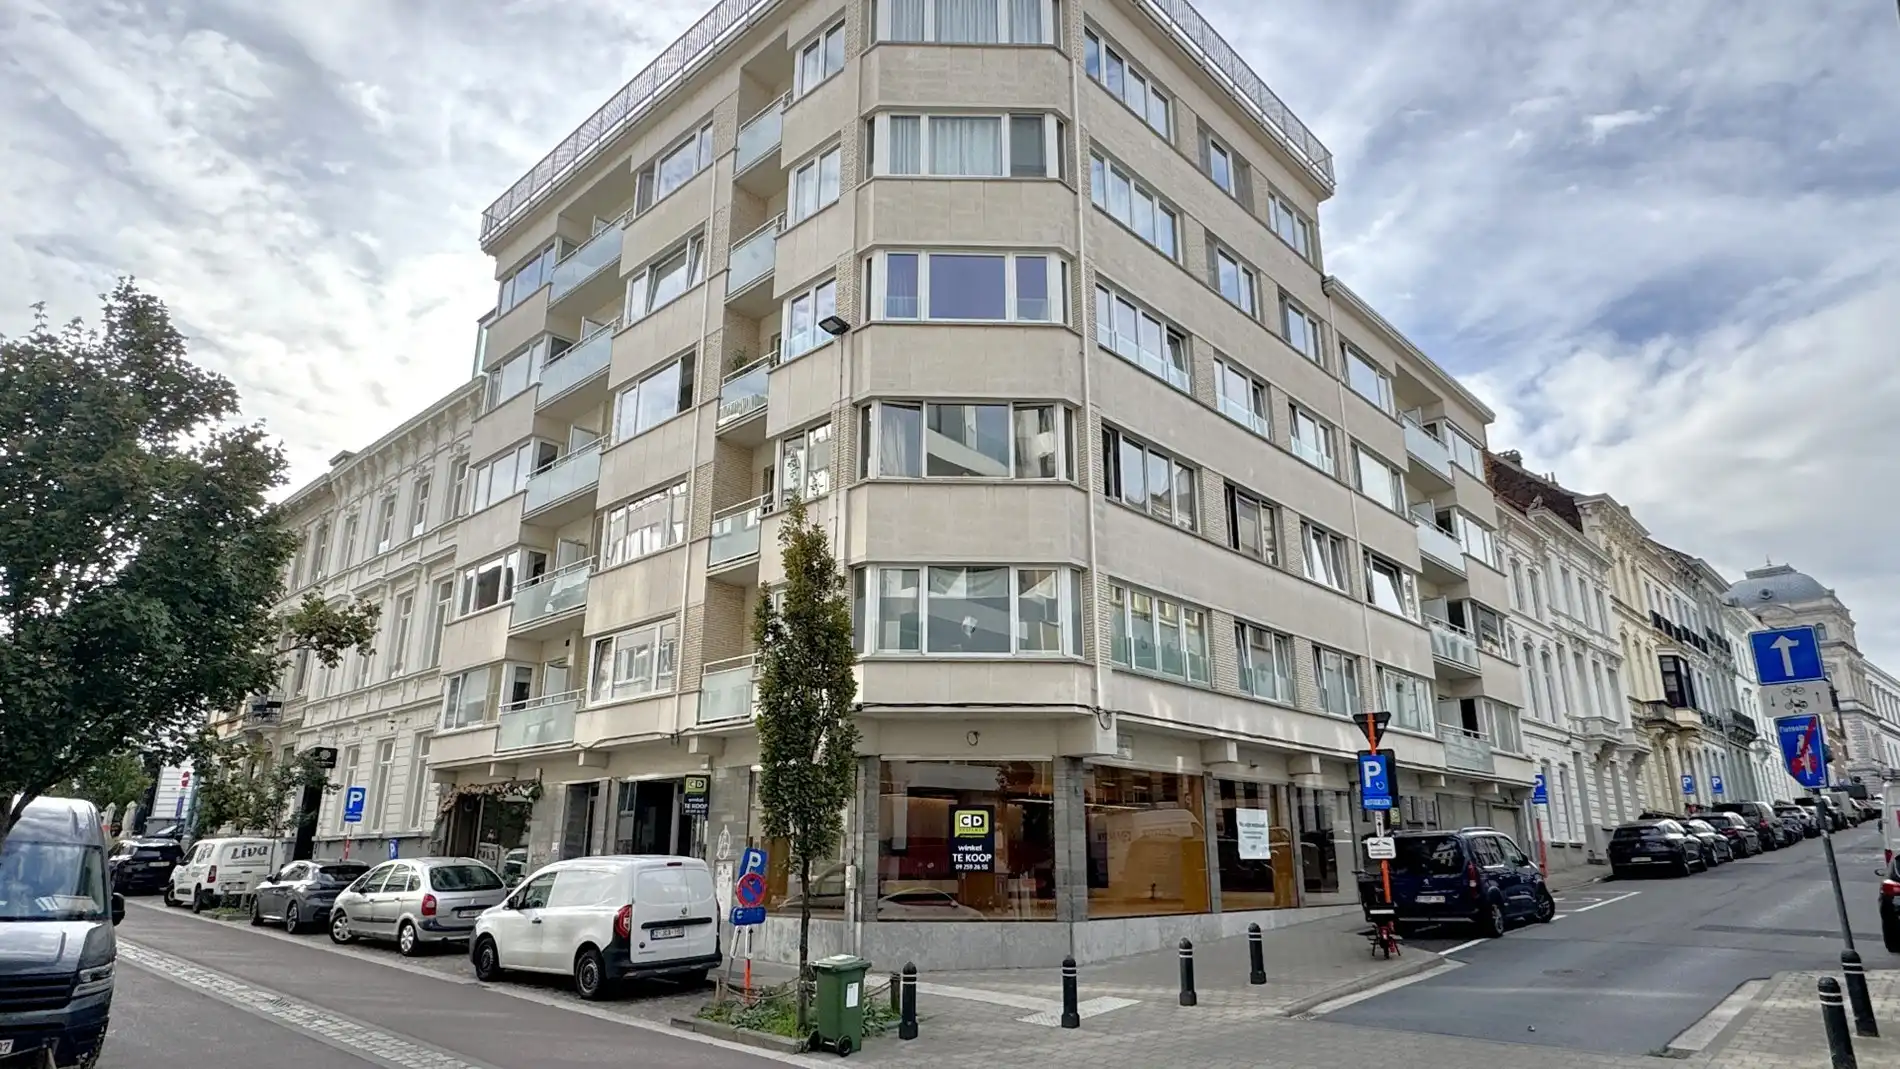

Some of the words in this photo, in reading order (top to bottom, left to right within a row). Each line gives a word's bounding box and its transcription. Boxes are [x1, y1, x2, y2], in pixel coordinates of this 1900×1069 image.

[1363, 761, 1381, 788] P
[688, 780, 703, 788] CD
[1682, 777, 1691, 788] P
[1711, 777, 1721, 788] P
[348, 791, 363, 809] P
[961, 815, 983, 827] CD
[231, 846, 268, 859] Liva
[952, 853, 964, 862] TE
[965, 853, 992, 862] KOOP
[745, 852, 762, 875] P
